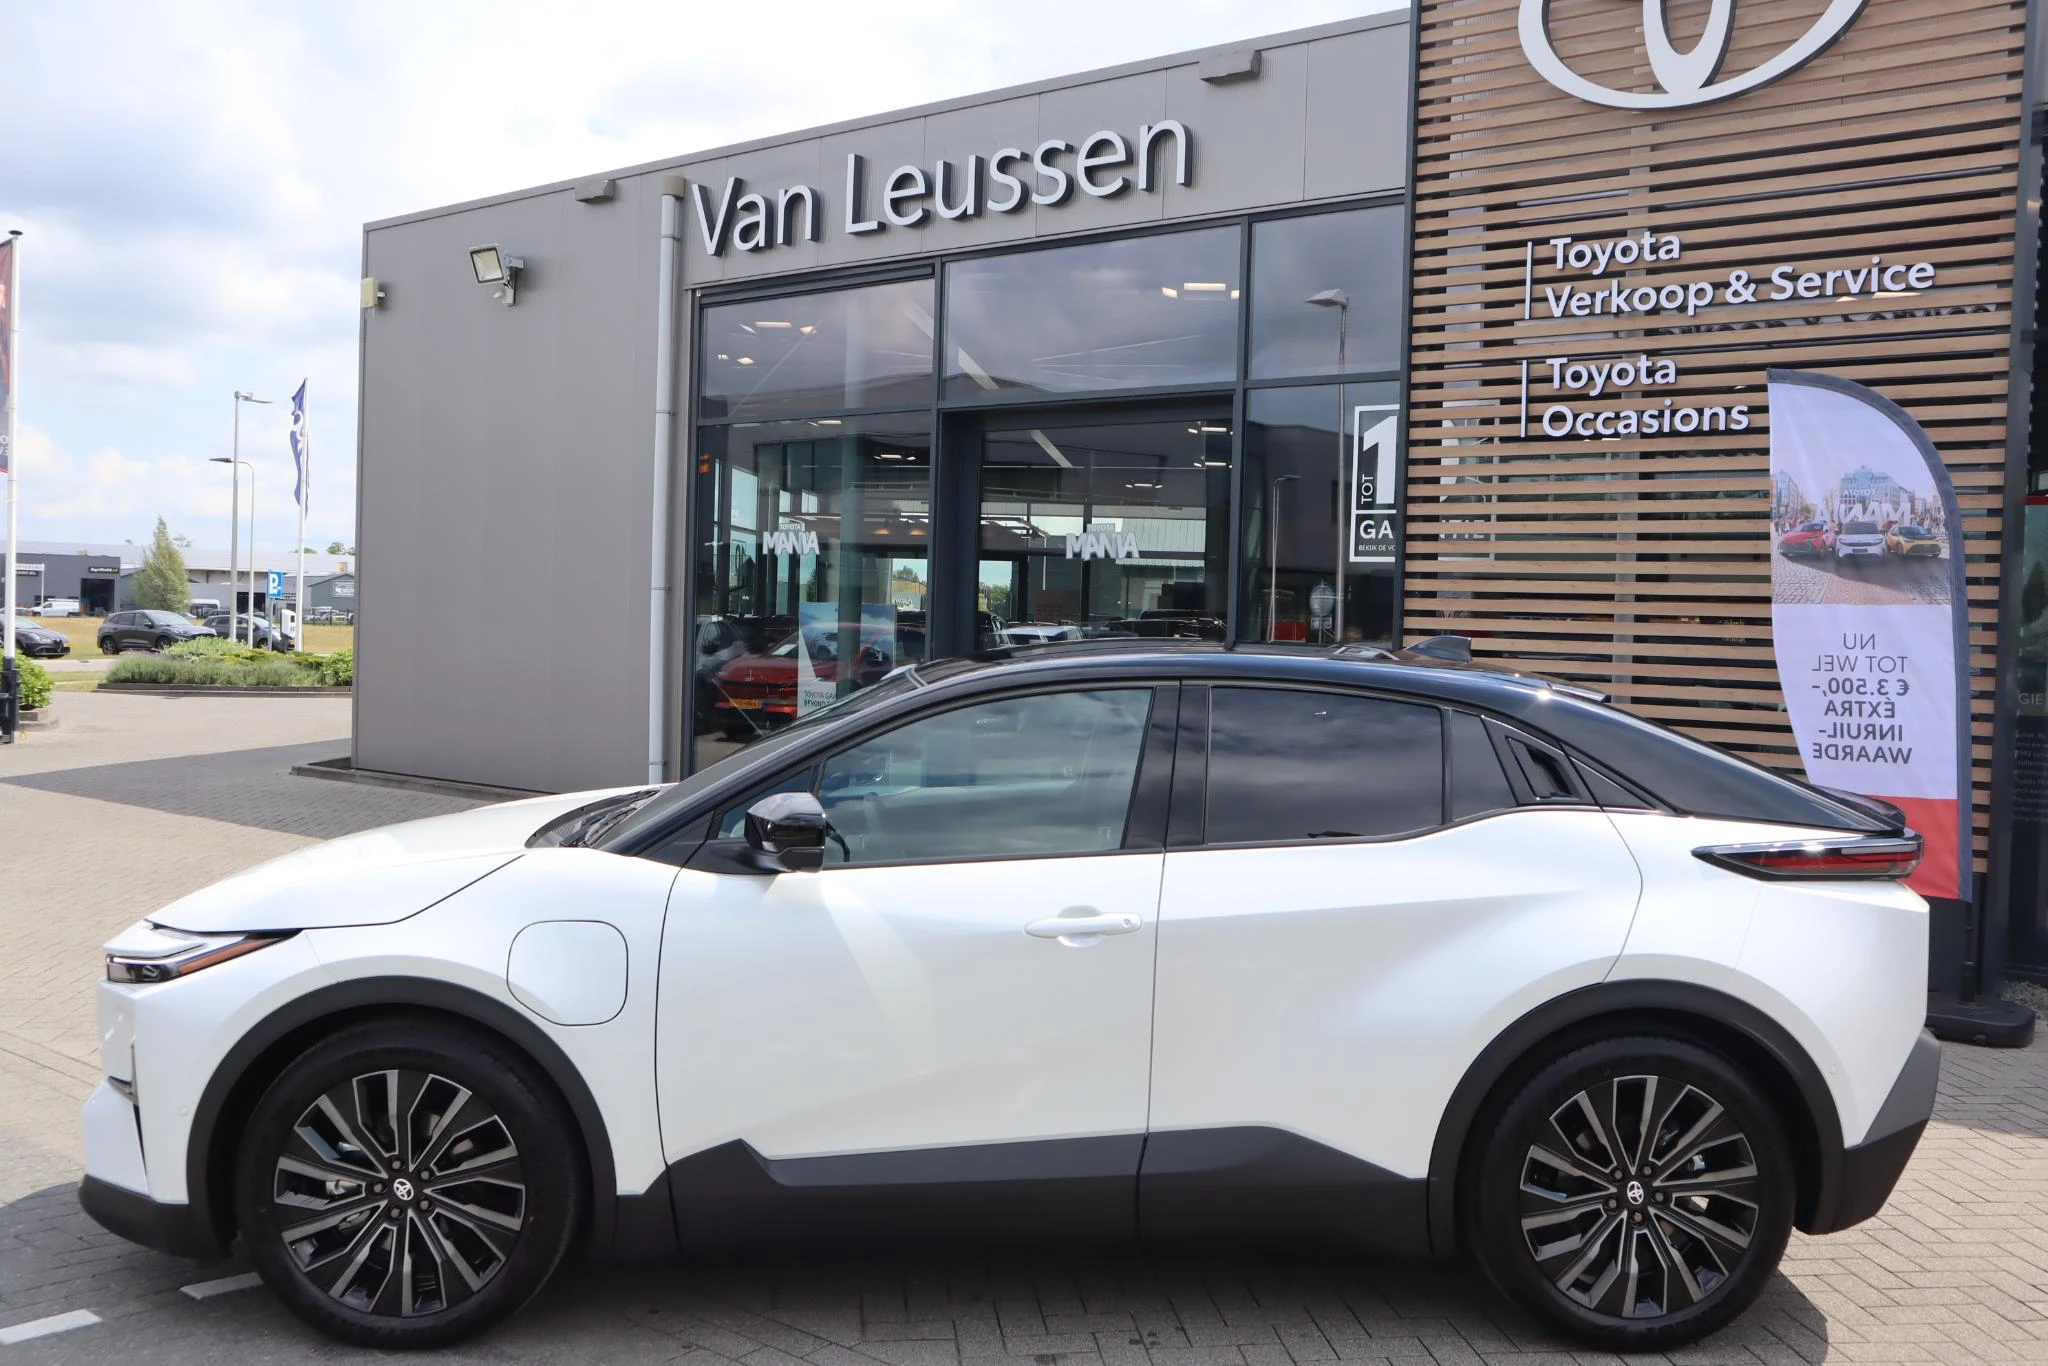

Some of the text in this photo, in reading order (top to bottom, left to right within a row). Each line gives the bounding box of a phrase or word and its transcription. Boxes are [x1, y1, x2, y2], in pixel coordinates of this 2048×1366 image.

[691, 118, 1193, 257] Van Leussen
[1549, 231, 1681, 276] Toyota
[1545, 255, 1935, 317] Verkoop & Service
[1545, 354, 1677, 396] Toyota
[1541, 398, 1749, 437] Occasions
[1360, 473, 1374, 505] TOT
[762, 531, 820, 555] MANIA
[780, 523, 801, 531] TOYOTA
[1087, 523, 1115, 532] TOYOTA
[1065, 532, 1140, 561] MANIA
